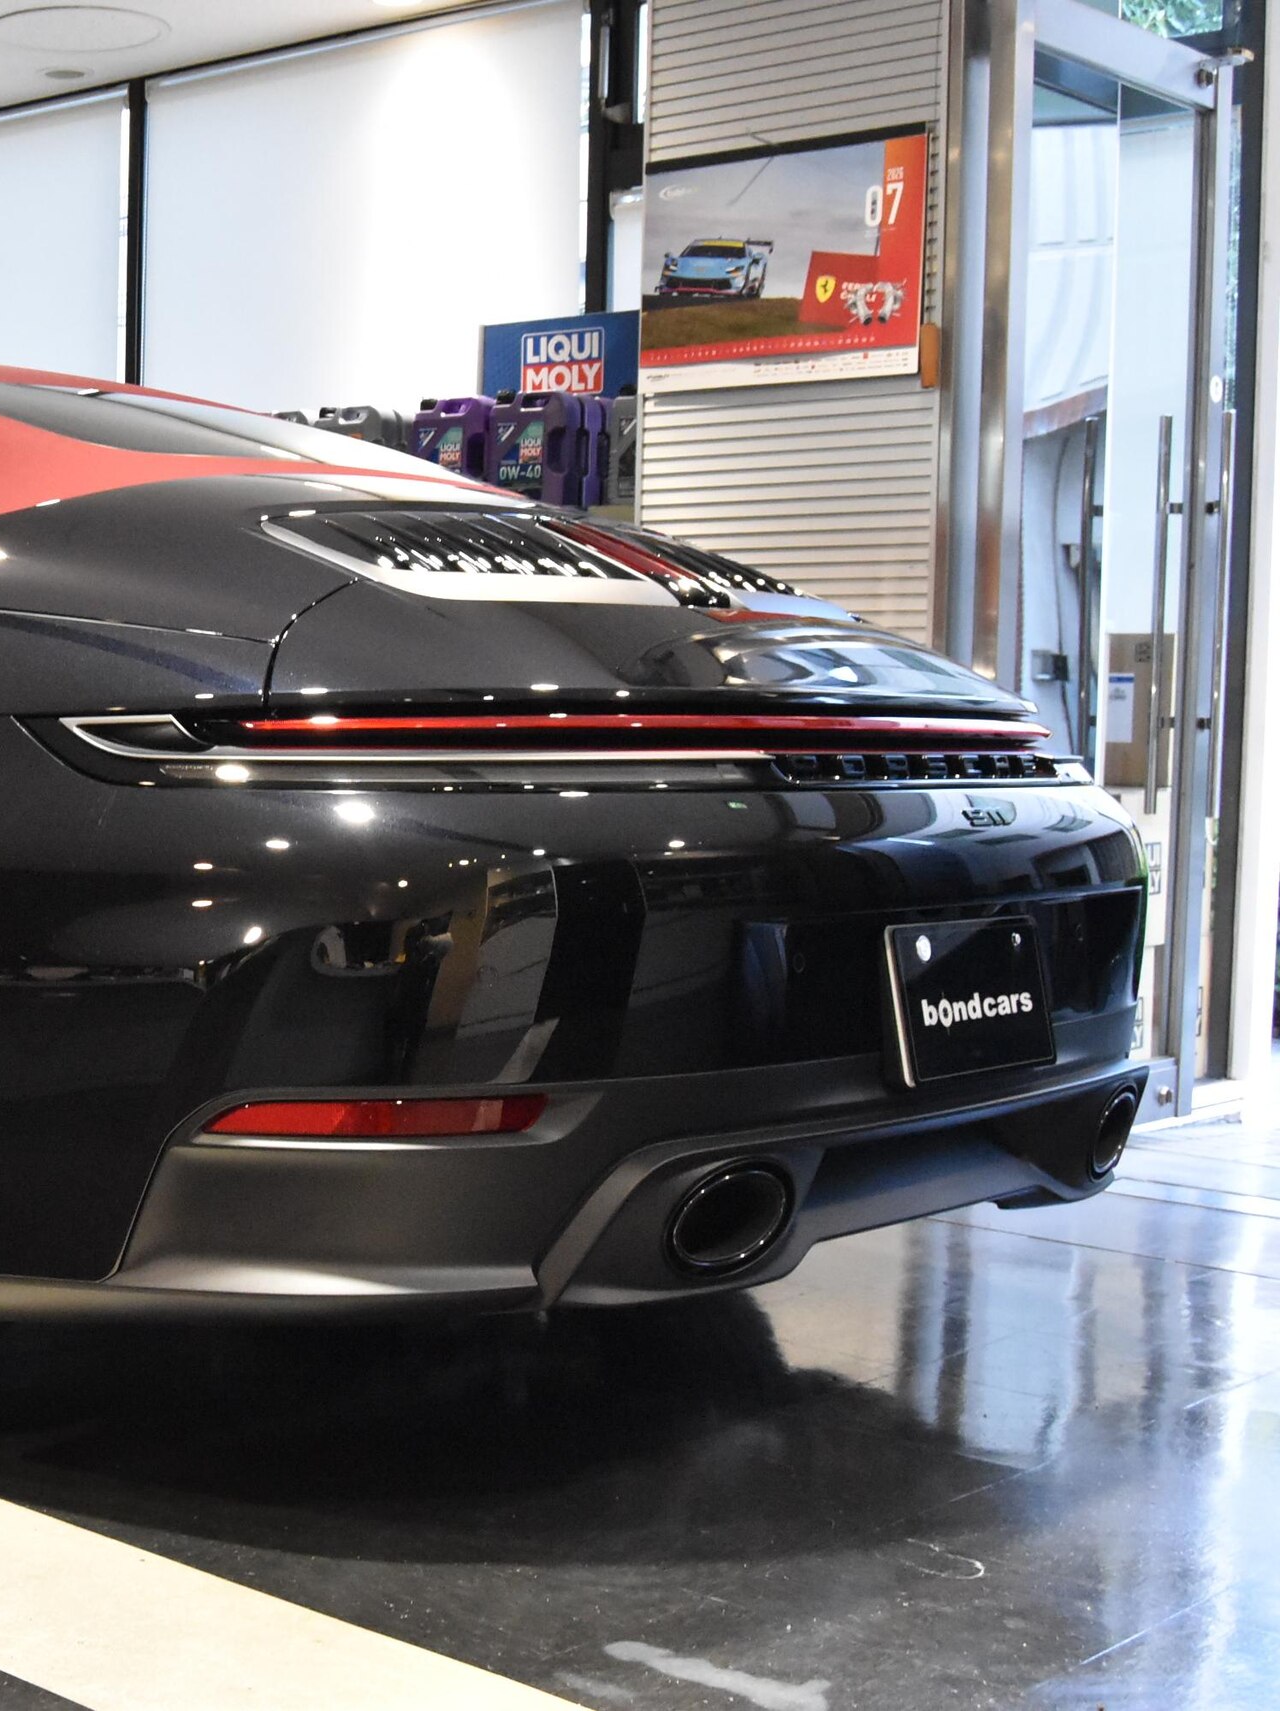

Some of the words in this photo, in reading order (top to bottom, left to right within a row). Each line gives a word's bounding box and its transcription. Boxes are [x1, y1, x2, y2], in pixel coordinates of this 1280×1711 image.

[864, 181, 904, 227] 07
[526, 331, 599, 364] LIQUI
[526, 362, 601, 394] MOLY
[499, 465, 542, 480] 0W-40
